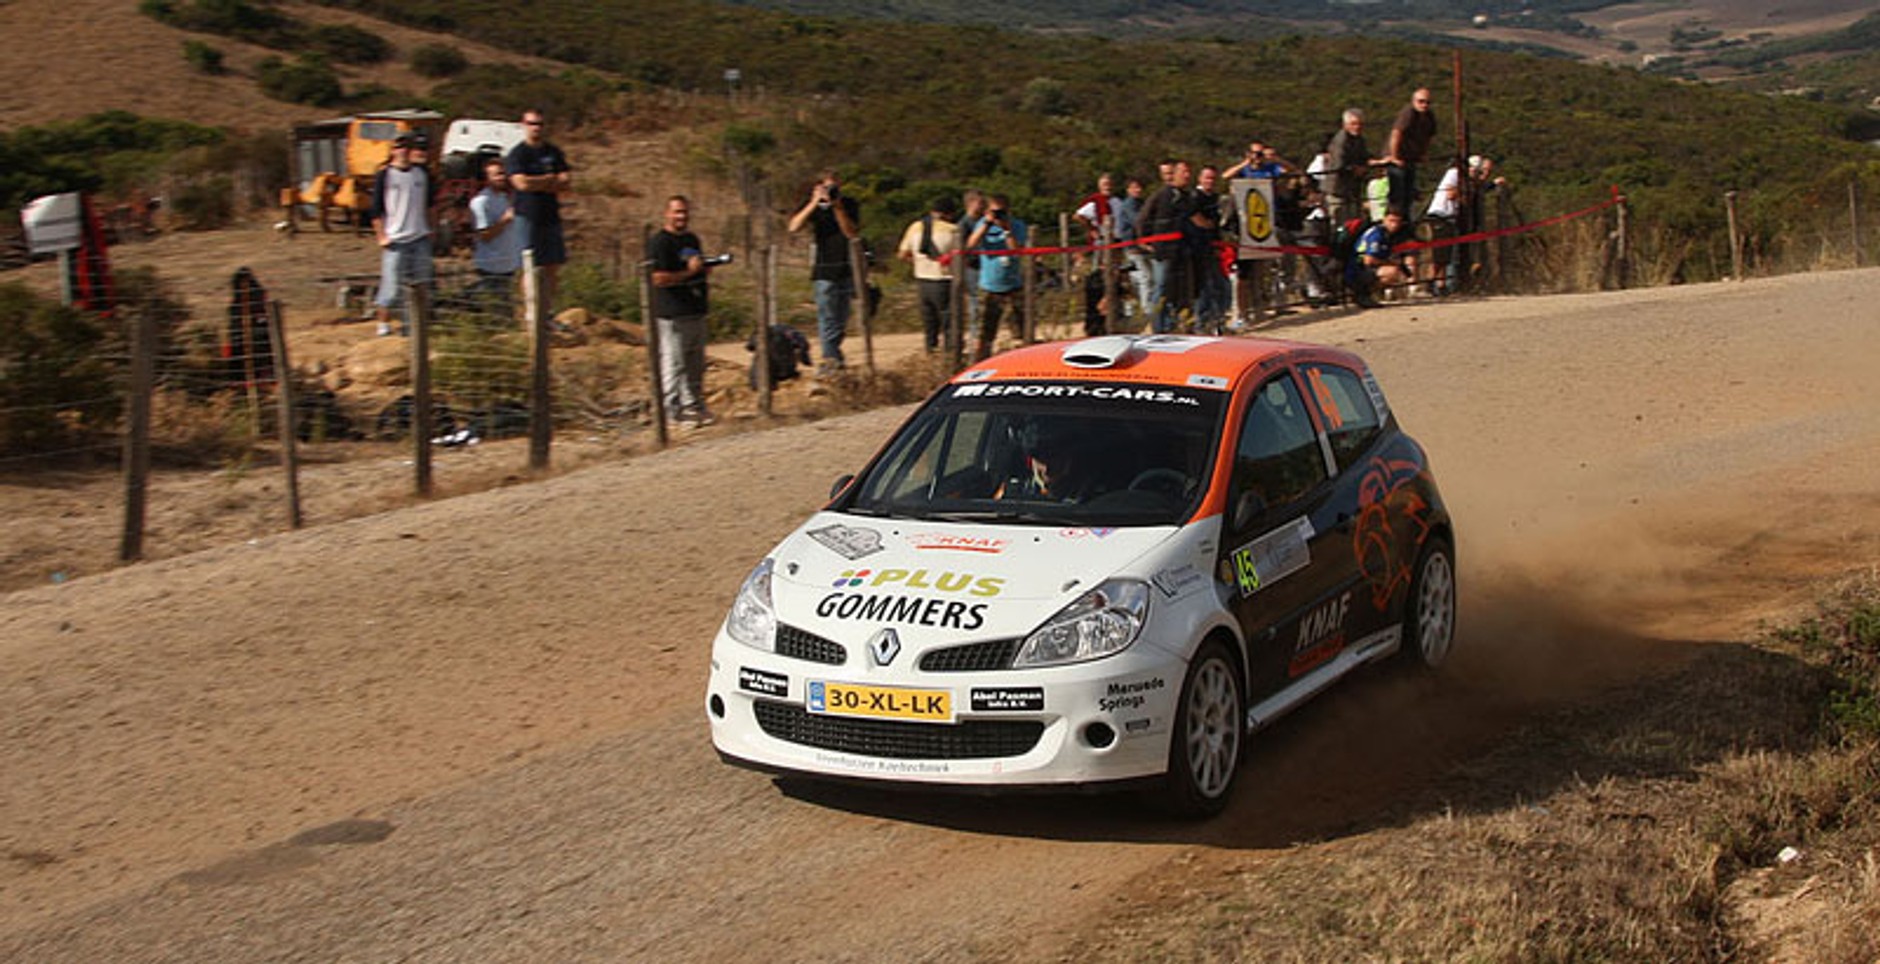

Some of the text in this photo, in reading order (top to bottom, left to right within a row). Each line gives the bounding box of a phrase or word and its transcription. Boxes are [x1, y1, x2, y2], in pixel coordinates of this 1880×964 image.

[870, 569, 1006, 597] PLUS
[1235, 549, 1261, 593] 45
[816, 592, 988, 630] GOMMERS
[1295, 590, 1352, 652] KNAF
[829, 689, 944, 714] 30-XL-LK
[1099, 695, 1145, 713] Springs
